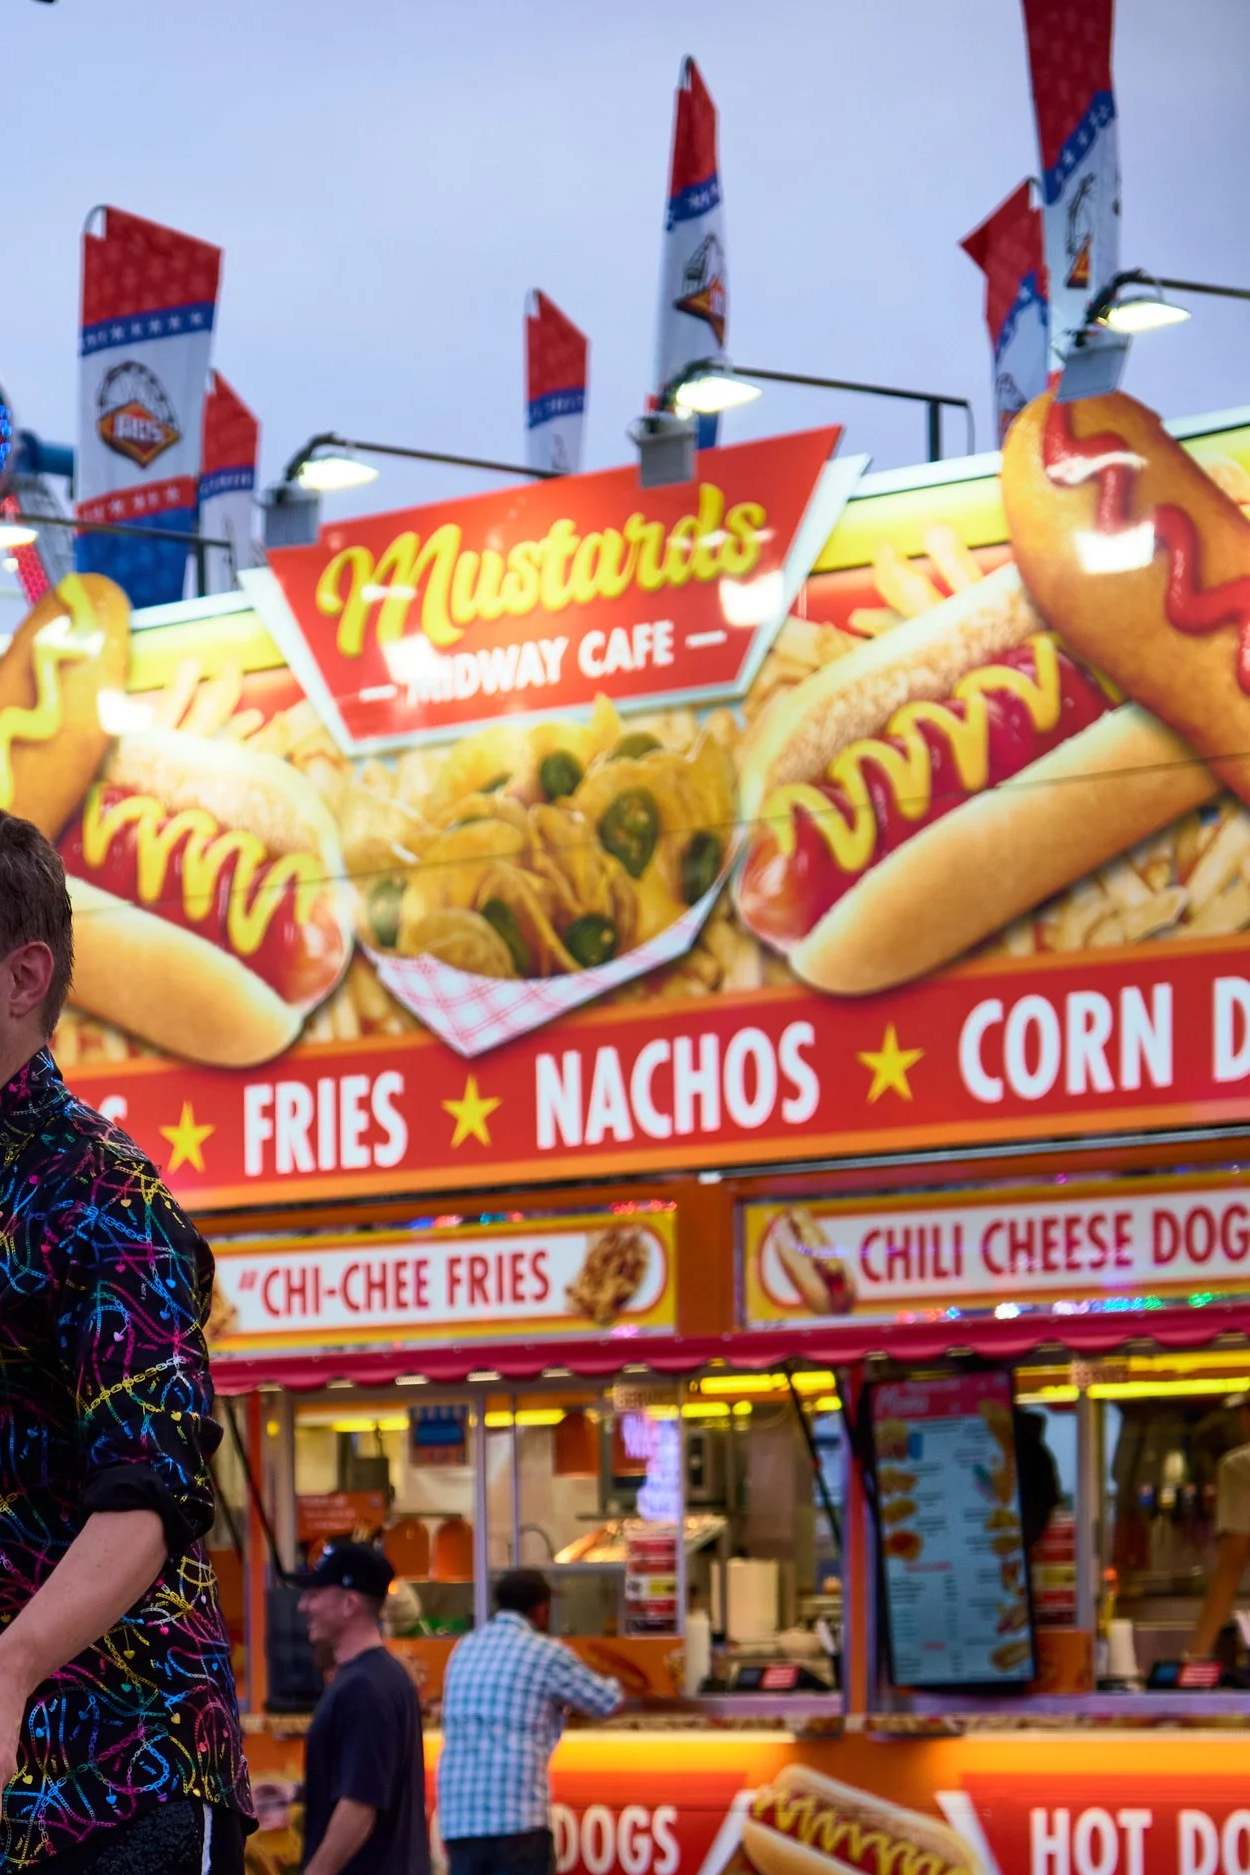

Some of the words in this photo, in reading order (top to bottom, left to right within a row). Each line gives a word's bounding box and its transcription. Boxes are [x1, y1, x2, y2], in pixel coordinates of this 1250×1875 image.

[316, 482, 766, 657] Mustards
[578, 620, 674, 677] CAFE
[535, 1021, 820, 1150] NACHOS
[958, 983, 1173, 1103] CORN
[243, 1070, 408, 1176] FRIES
[446, 1251, 551, 1308] FRIES
[859, 1220, 964, 1284] CHILI
[981, 1209, 1134, 1276] CHEESE
[1152, 1202, 1250, 1267] DOG
